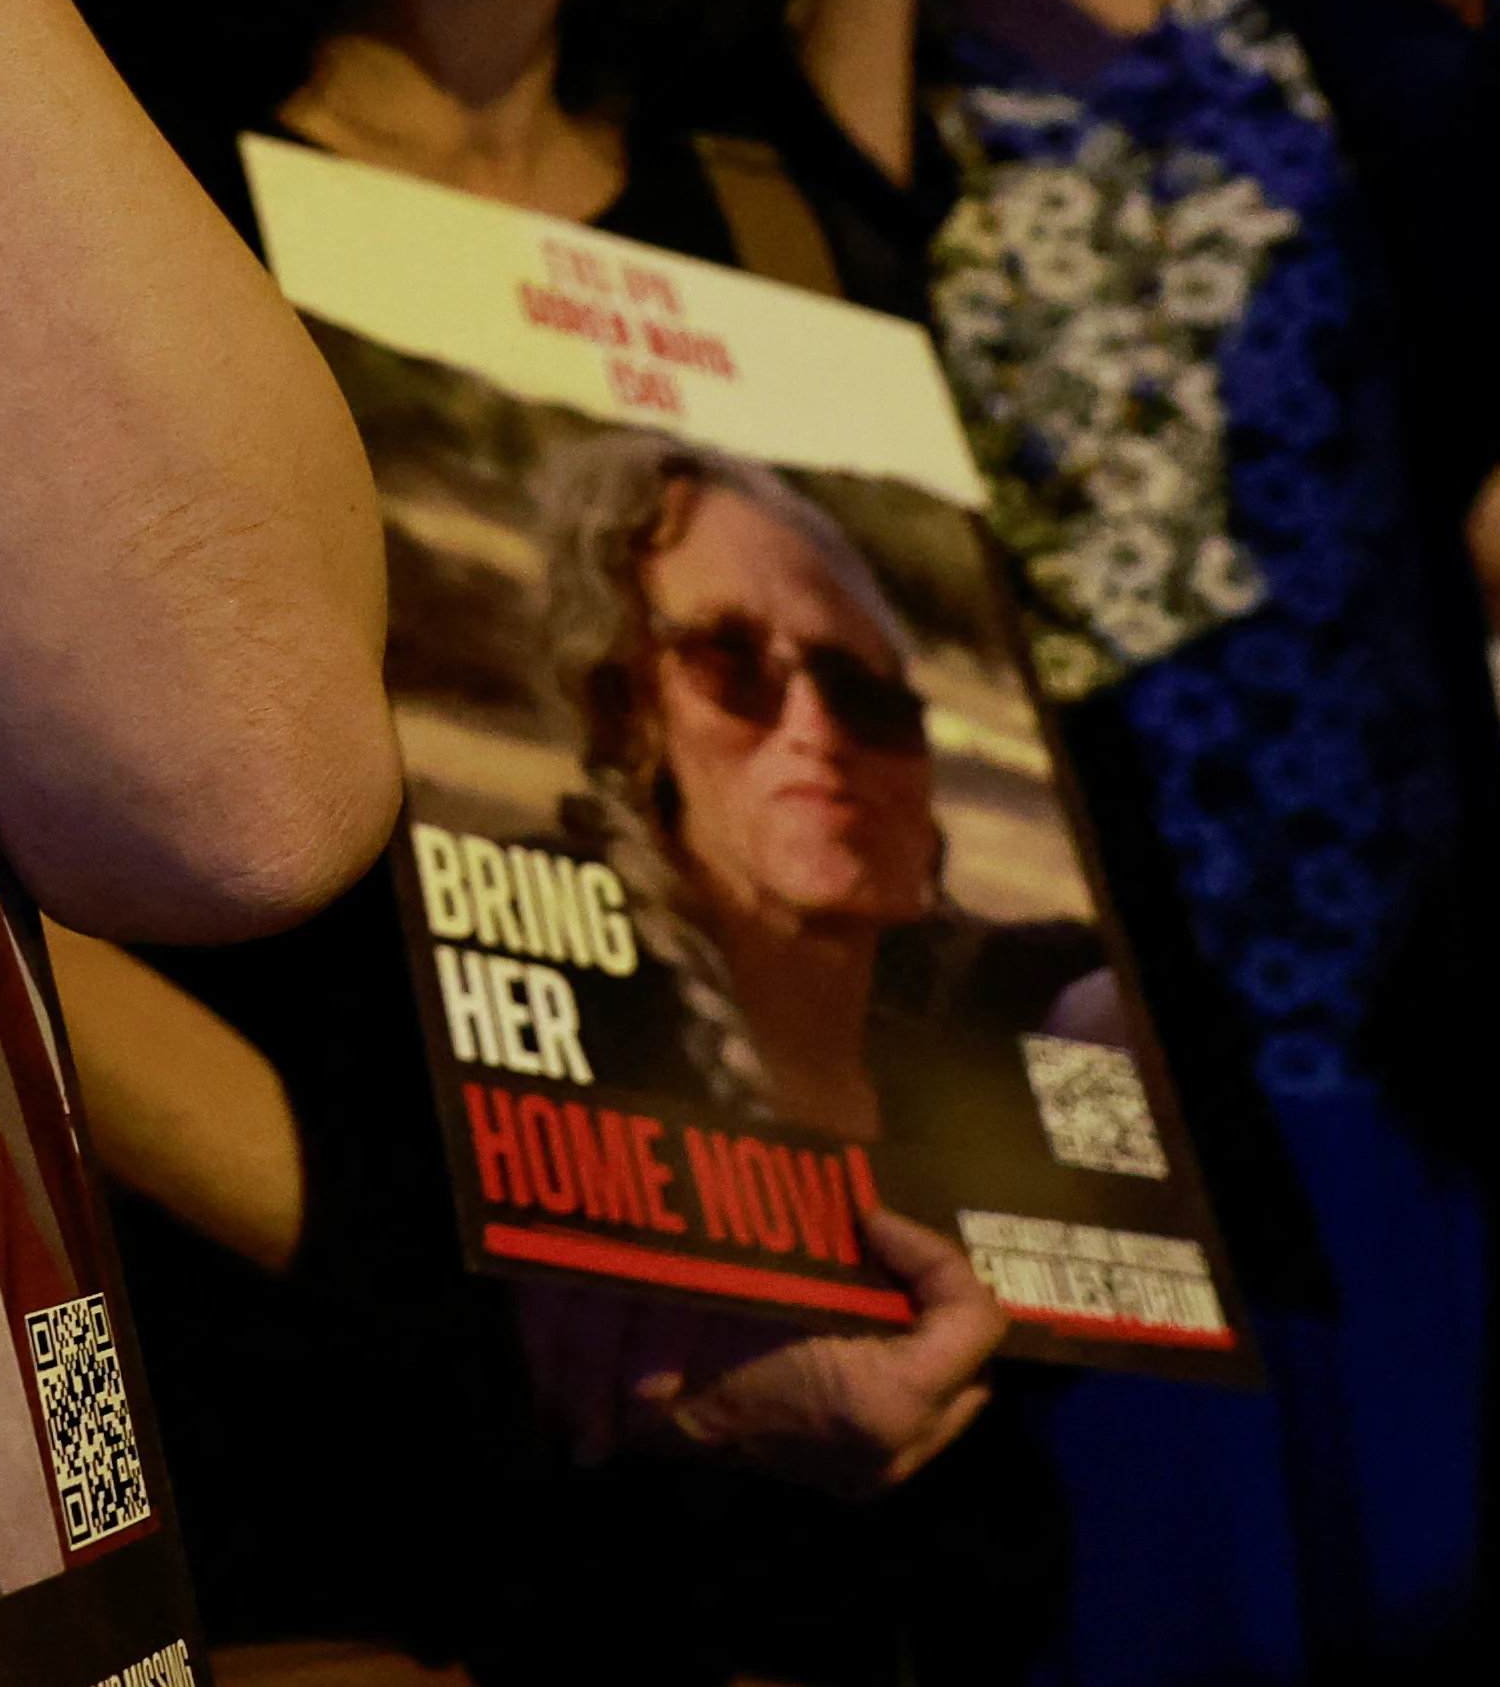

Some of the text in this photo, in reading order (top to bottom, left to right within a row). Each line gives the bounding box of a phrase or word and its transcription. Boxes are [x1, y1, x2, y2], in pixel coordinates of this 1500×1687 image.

[411, 822, 639, 979] BRING
[434, 944, 595, 1085] HER
[462, 1082, 683, 1237] HOME
